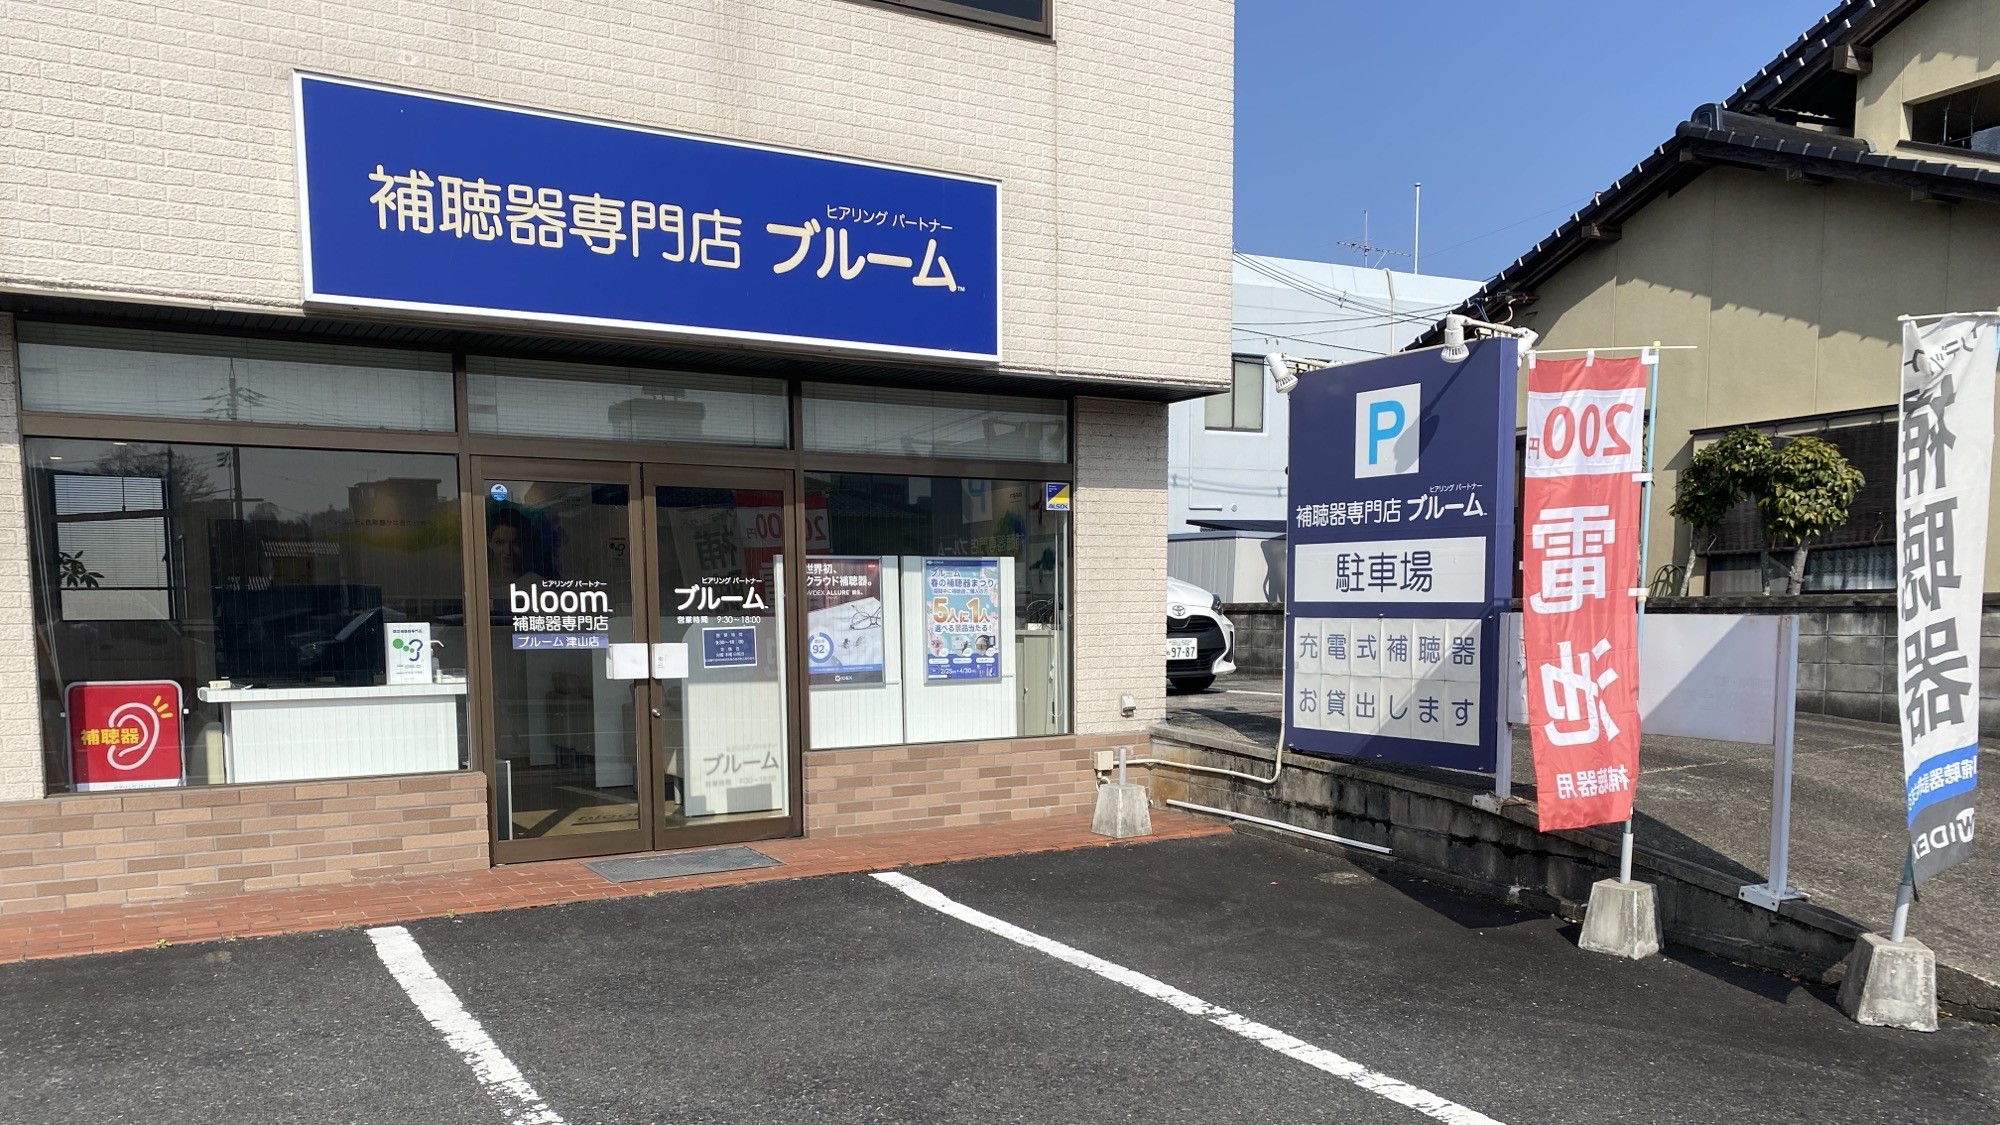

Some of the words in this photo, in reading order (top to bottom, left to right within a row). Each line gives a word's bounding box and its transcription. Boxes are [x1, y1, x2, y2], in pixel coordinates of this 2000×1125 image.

[368, 164, 742, 269] 補聴器専門店
[826, 204, 889, 226] ヒアリング
[892, 213, 953, 233] パートナー
[1368, 400, 1406, 465] P
[1429, 484, 1455, 493] ヒアリング
[1455, 483, 1483, 491] パートナー
[1296, 498, 1402, 528] 補聴器専門店
[806, 563, 837, 574] 世界初、
[930, 568, 961, 577] ブルーム
[1336, 550, 1433, 593] 駐車場
[541, 580, 574, 588] ヒアリング
[575, 580, 607, 588] パートナー
[701, 577, 731, 585] ヒアリング
[732, 577, 763, 585] パートナー
[806, 575, 872, 587] クラウド補聴器。
[931, 579, 994, 587] 春の補聴器まつり
[510, 583, 609, 614] bloom
[674, 584, 765, 611] ブルーム
[933, 597, 991, 623] 5人に1人
[512, 615, 609, 632] 補聴器専門店
[677, 615, 709, 624] 営業時間
[518, 636, 564, 647] ブルーム
[566, 636, 600, 647] 津山店
[1298, 632, 1475, 666] 充電式補聴器
[1299, 687, 1474, 727] お貸出します
[81, 727, 139, 745] 補聴器
